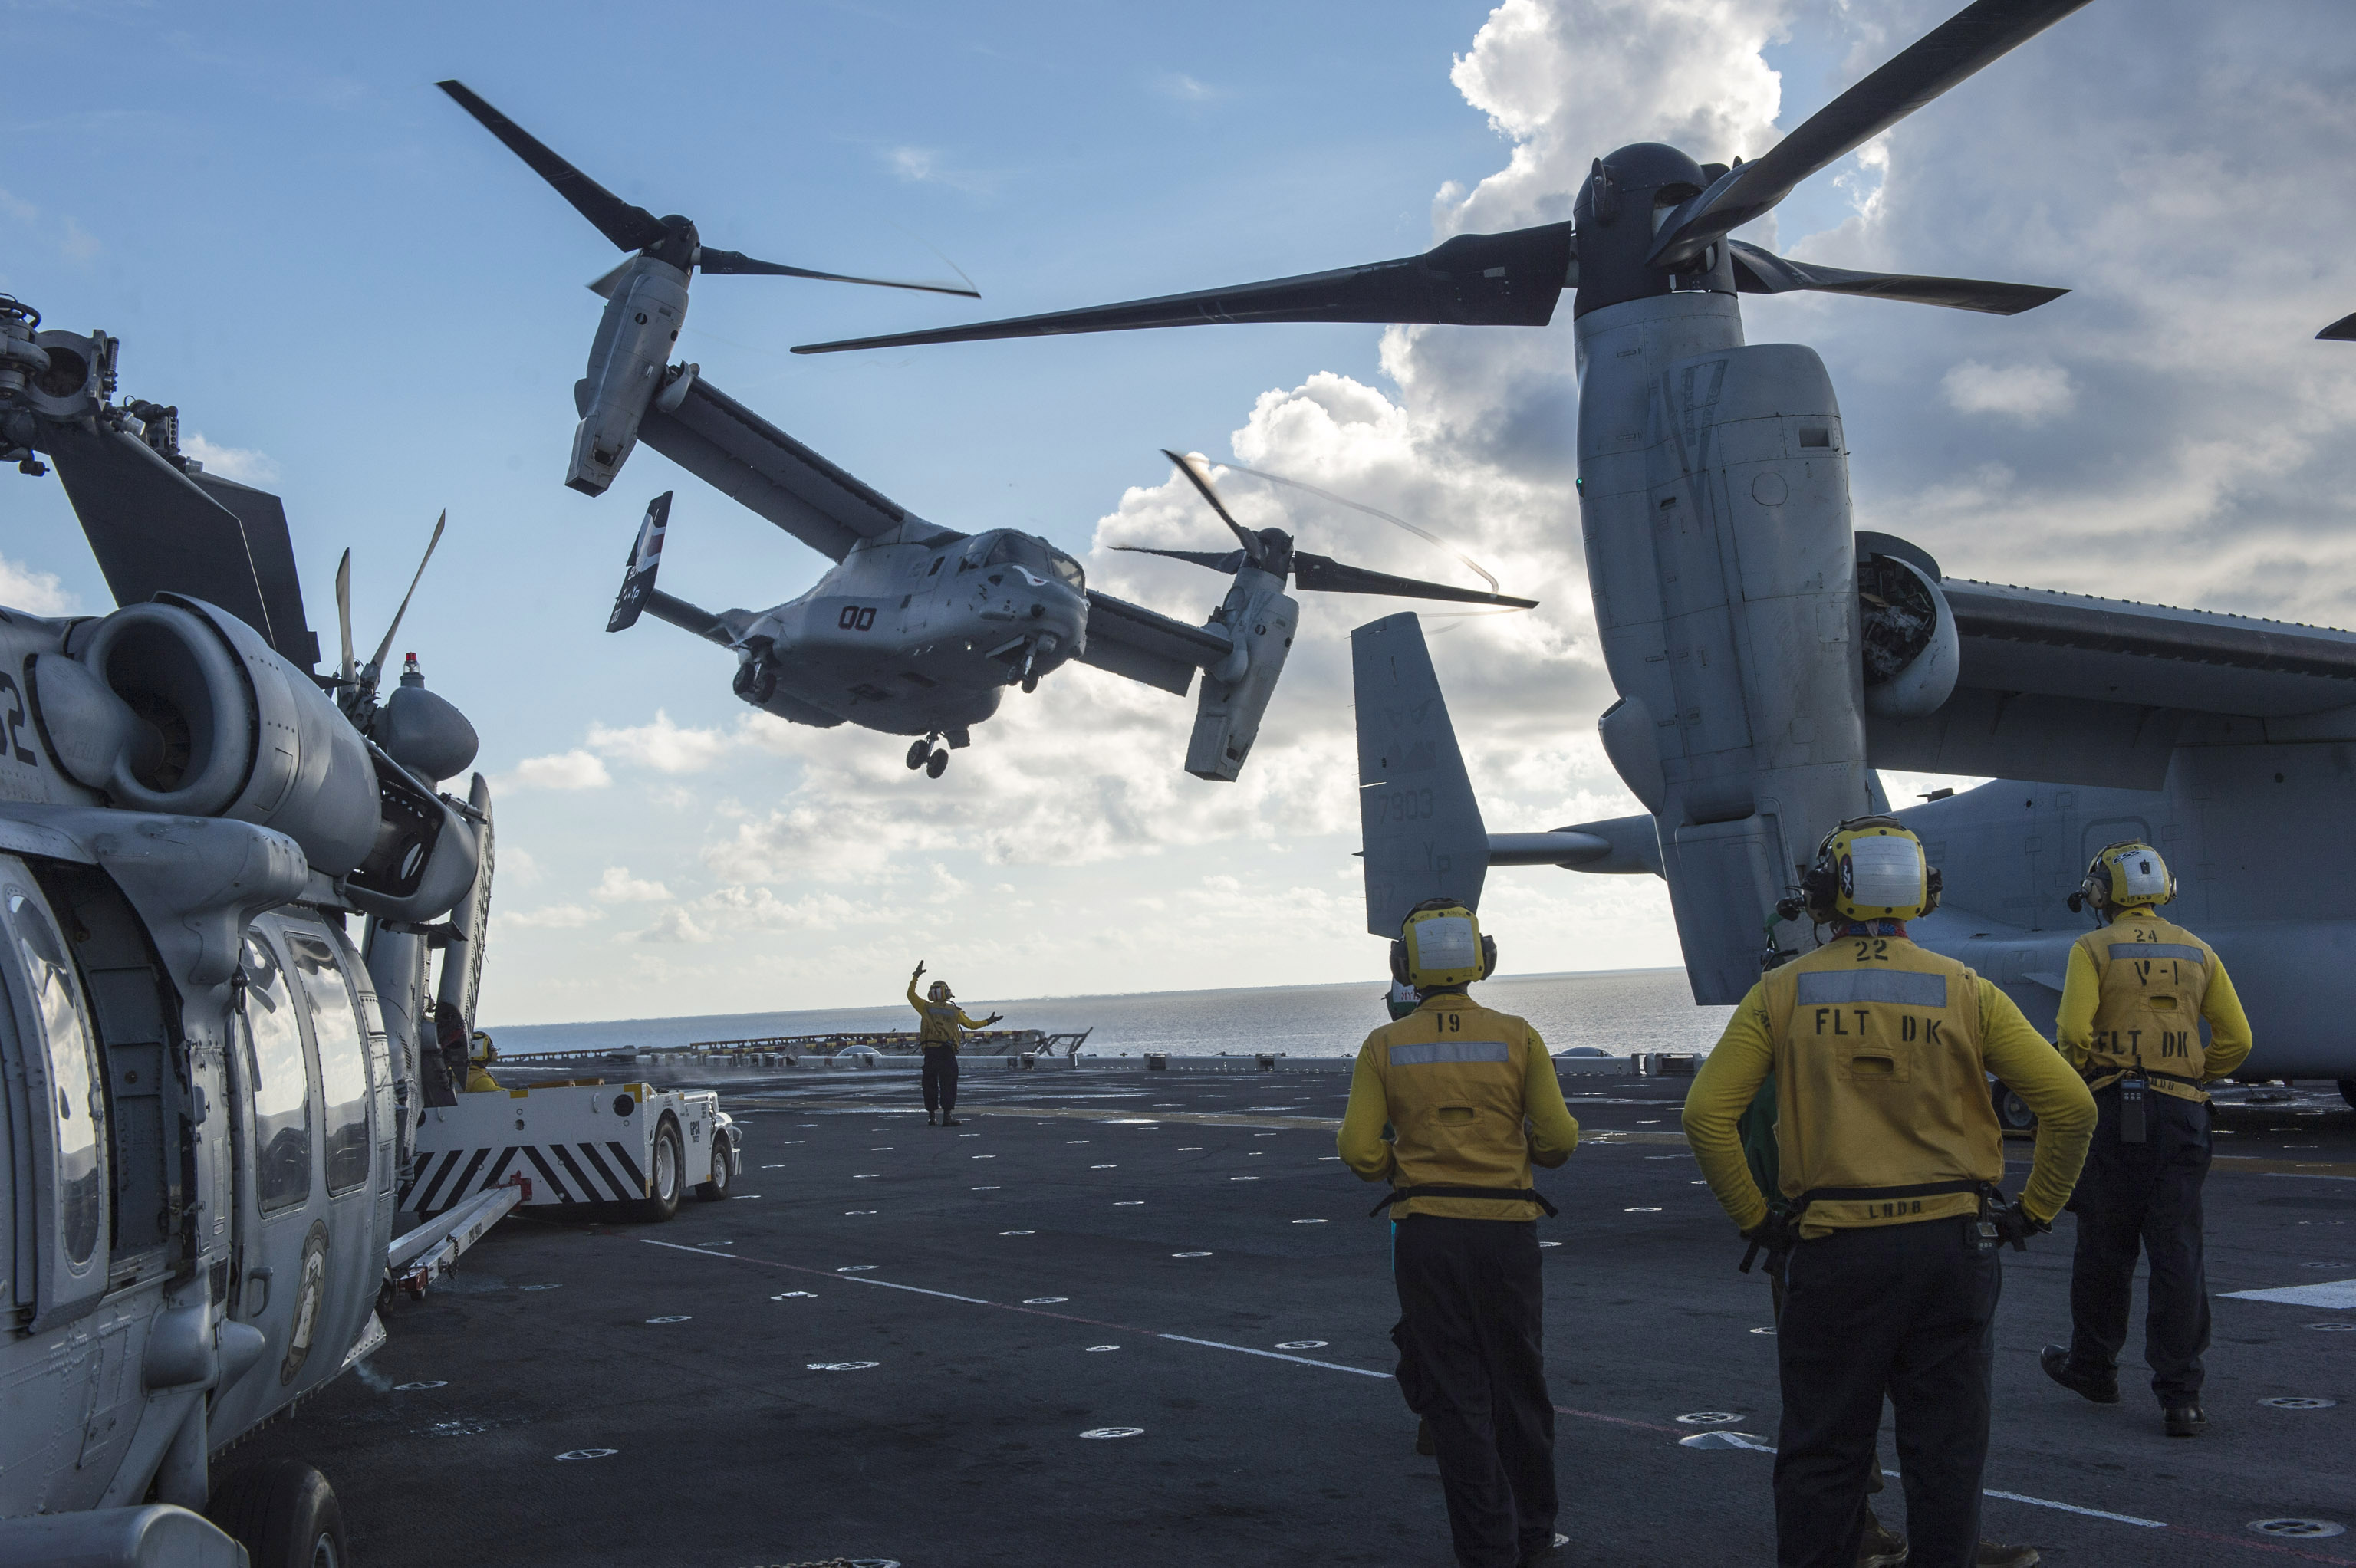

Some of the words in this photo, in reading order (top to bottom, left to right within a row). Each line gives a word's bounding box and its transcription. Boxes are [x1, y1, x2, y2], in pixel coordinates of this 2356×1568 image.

[838, 605, 877, 632] 00
[0, 670, 38, 768] 2
[1378, 787, 1435, 825] 7903
[2134, 929, 2158, 943] 24
[1854, 939, 1889, 962] 22
[1437, 1012, 1460, 1033] 19
[1815, 1008, 1870, 1036] FLT
[1901, 1014, 1943, 1046] DK
[2097, 1030, 2142, 1057] FLT
[2162, 1031, 2189, 1058] DK
[1869, 1200, 1921, 1219] LHD8
